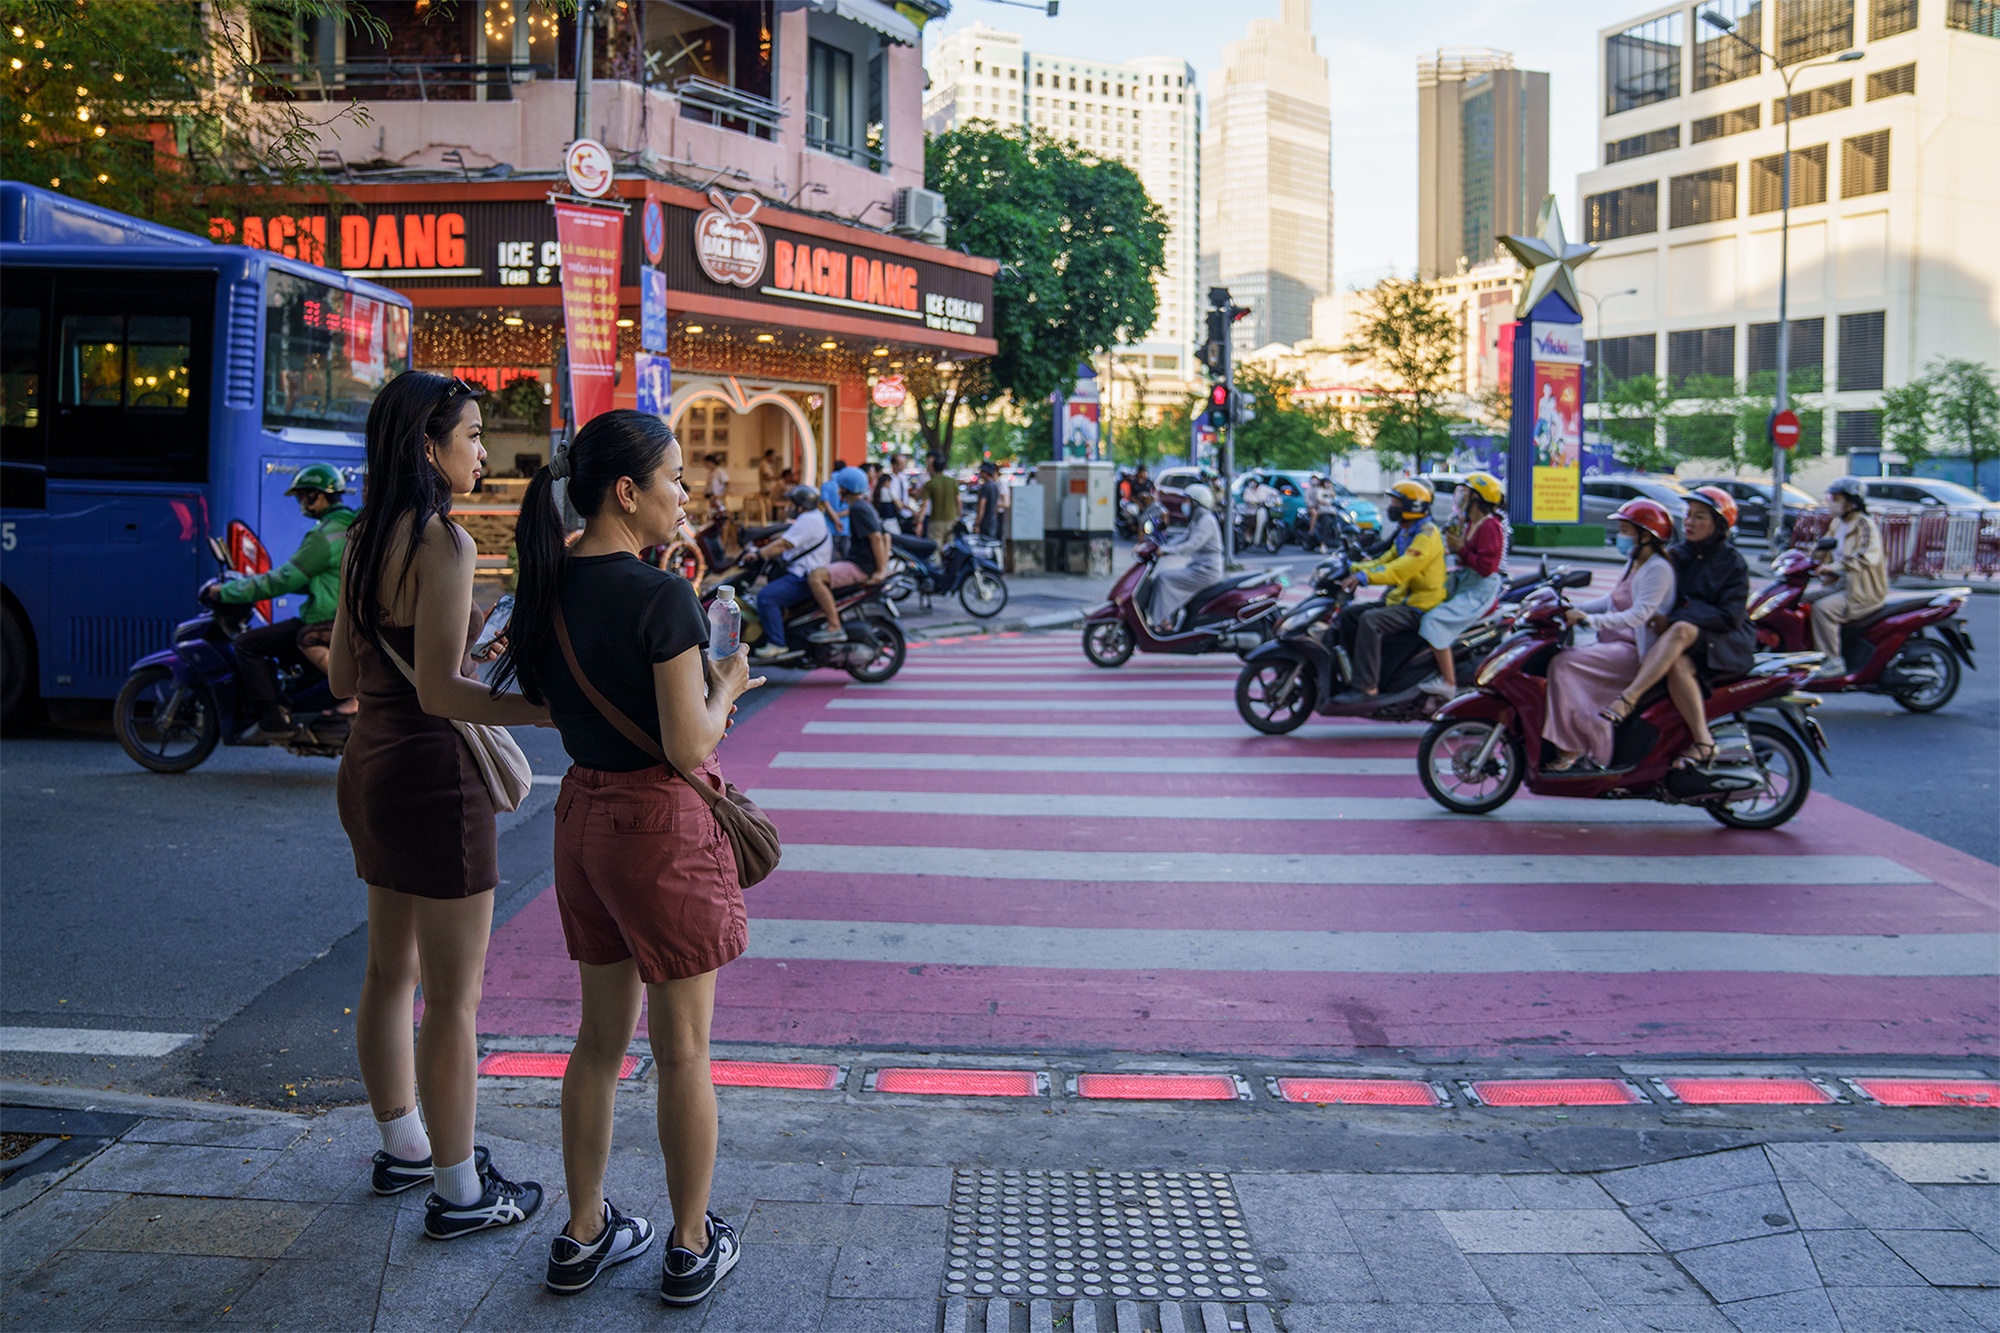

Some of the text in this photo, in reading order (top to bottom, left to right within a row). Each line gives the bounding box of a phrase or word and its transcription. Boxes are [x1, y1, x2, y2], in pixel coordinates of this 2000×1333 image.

[340, 213, 465, 268] DANG
[498, 241, 535, 268] ICE
[498, 266, 553, 286] Tea &
[774, 239, 918, 311] BACH DANG
[925, 293, 984, 323] ICE CREAM
